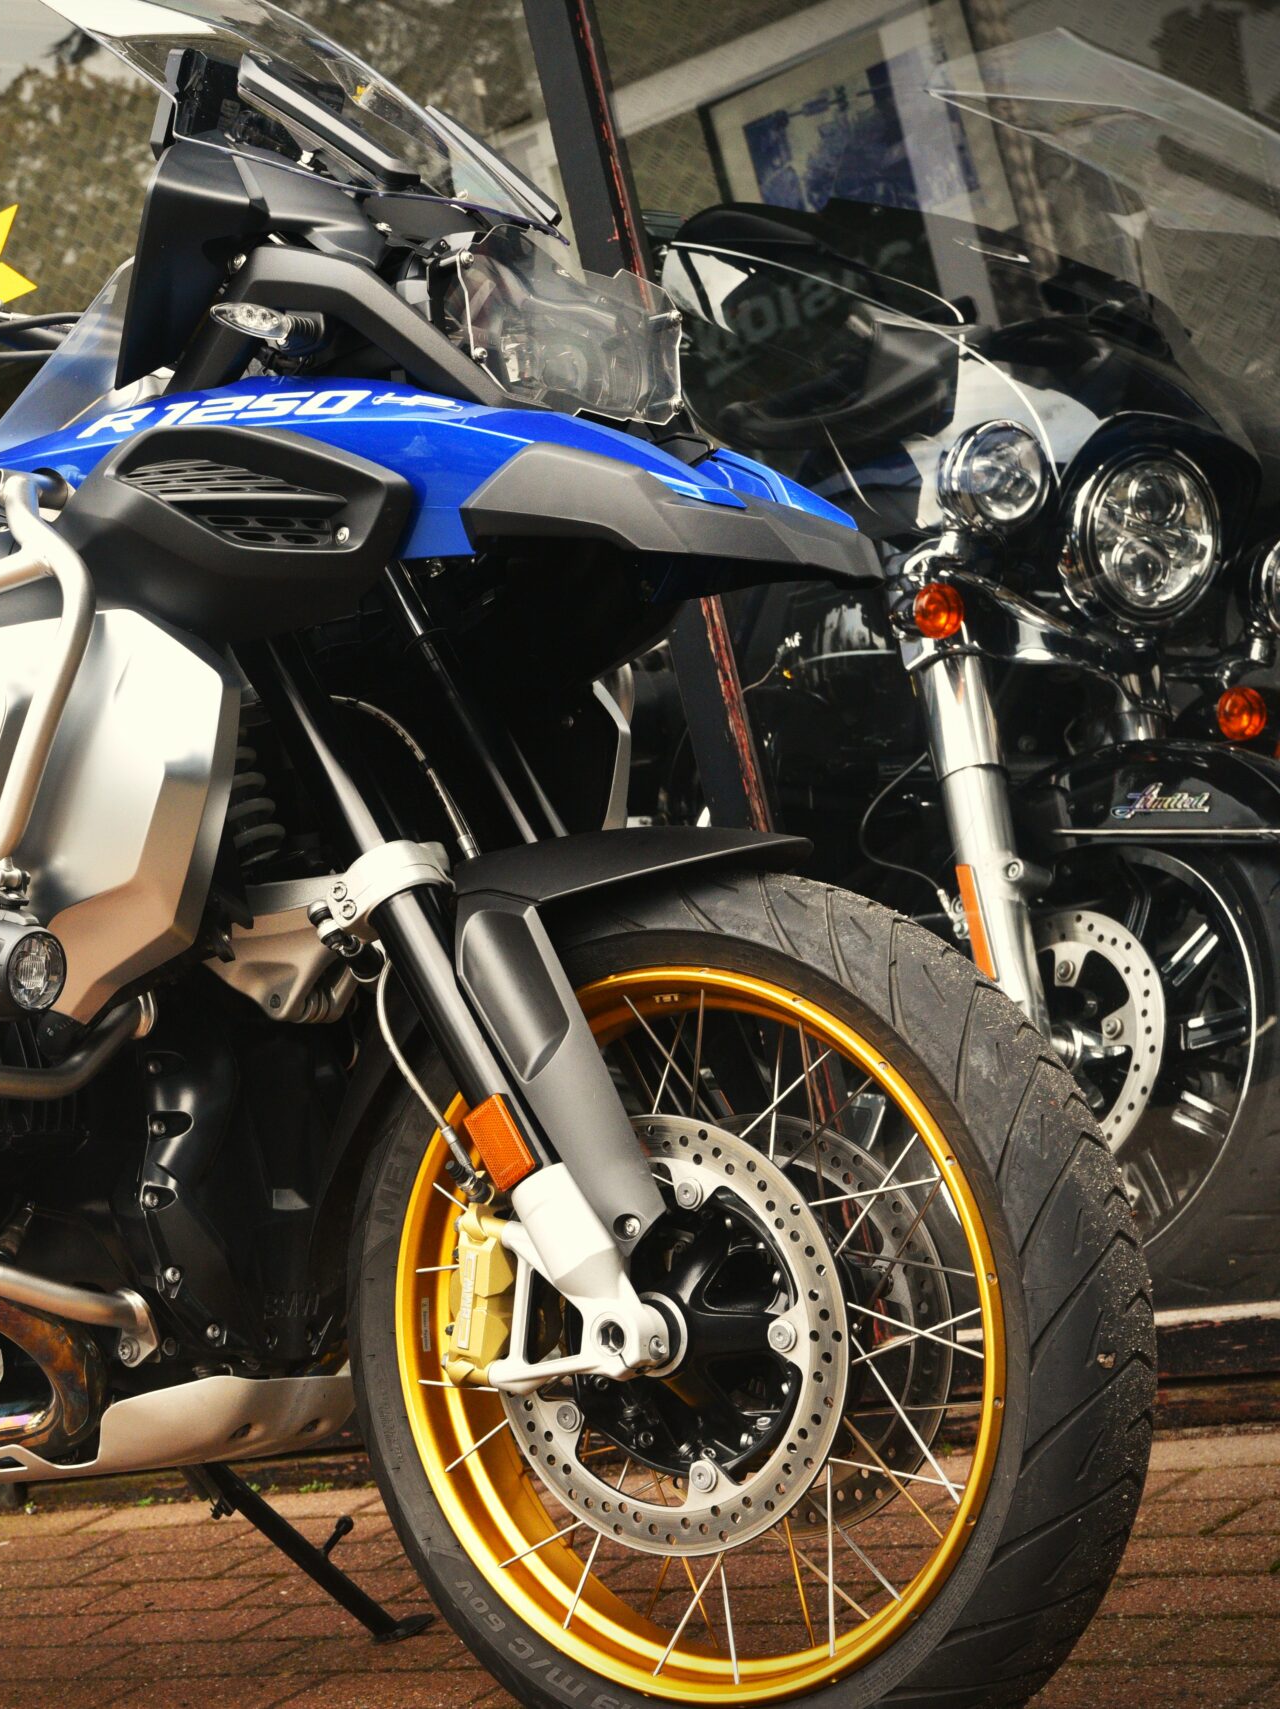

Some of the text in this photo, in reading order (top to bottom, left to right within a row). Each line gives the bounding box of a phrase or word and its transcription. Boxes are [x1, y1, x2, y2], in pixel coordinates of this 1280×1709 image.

[76, 406, 156, 440] R
[153, 390, 373, 427] 1250
[1109, 781, 1211, 820] Limited
[461, 1278, 474, 1320] BMW
[454, 1580, 506, 1633] 60V
[507, 1637, 588, 1698] M/C
